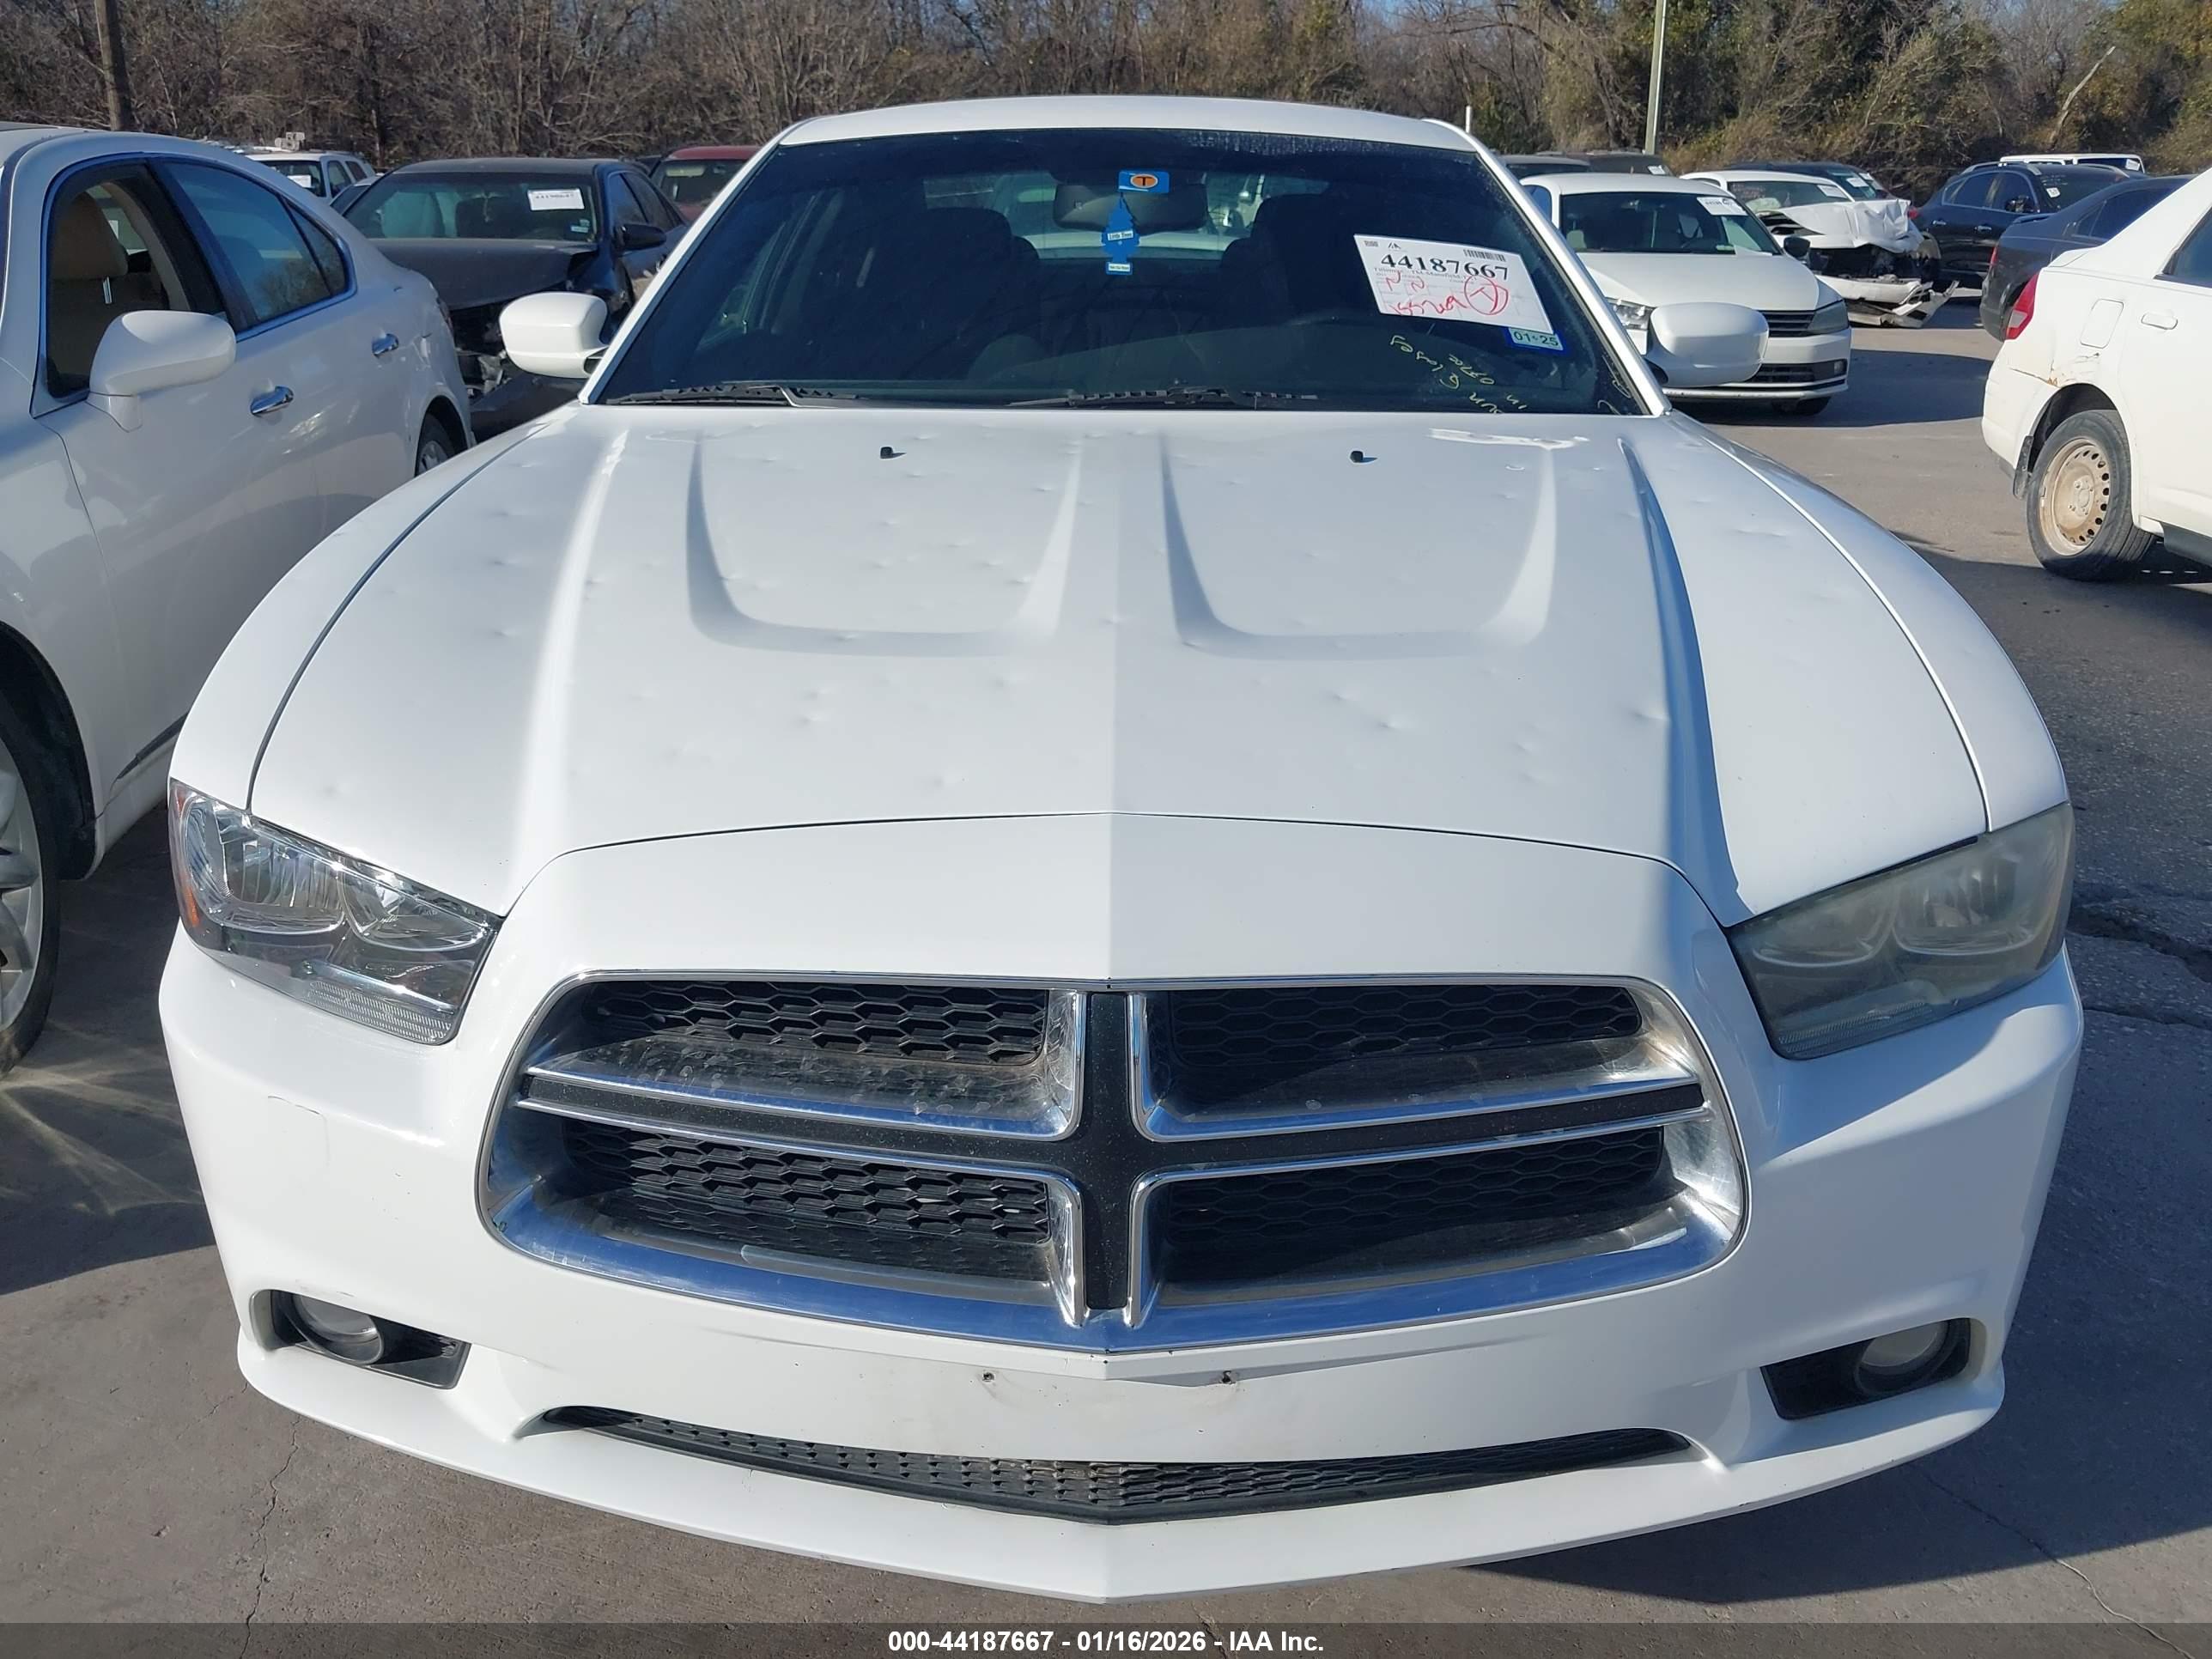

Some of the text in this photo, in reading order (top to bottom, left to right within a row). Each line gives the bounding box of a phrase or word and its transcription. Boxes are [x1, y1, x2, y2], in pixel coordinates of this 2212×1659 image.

[1381, 253, 1509, 281] 44187667
[1513, 331, 1559, 346] 01 25
